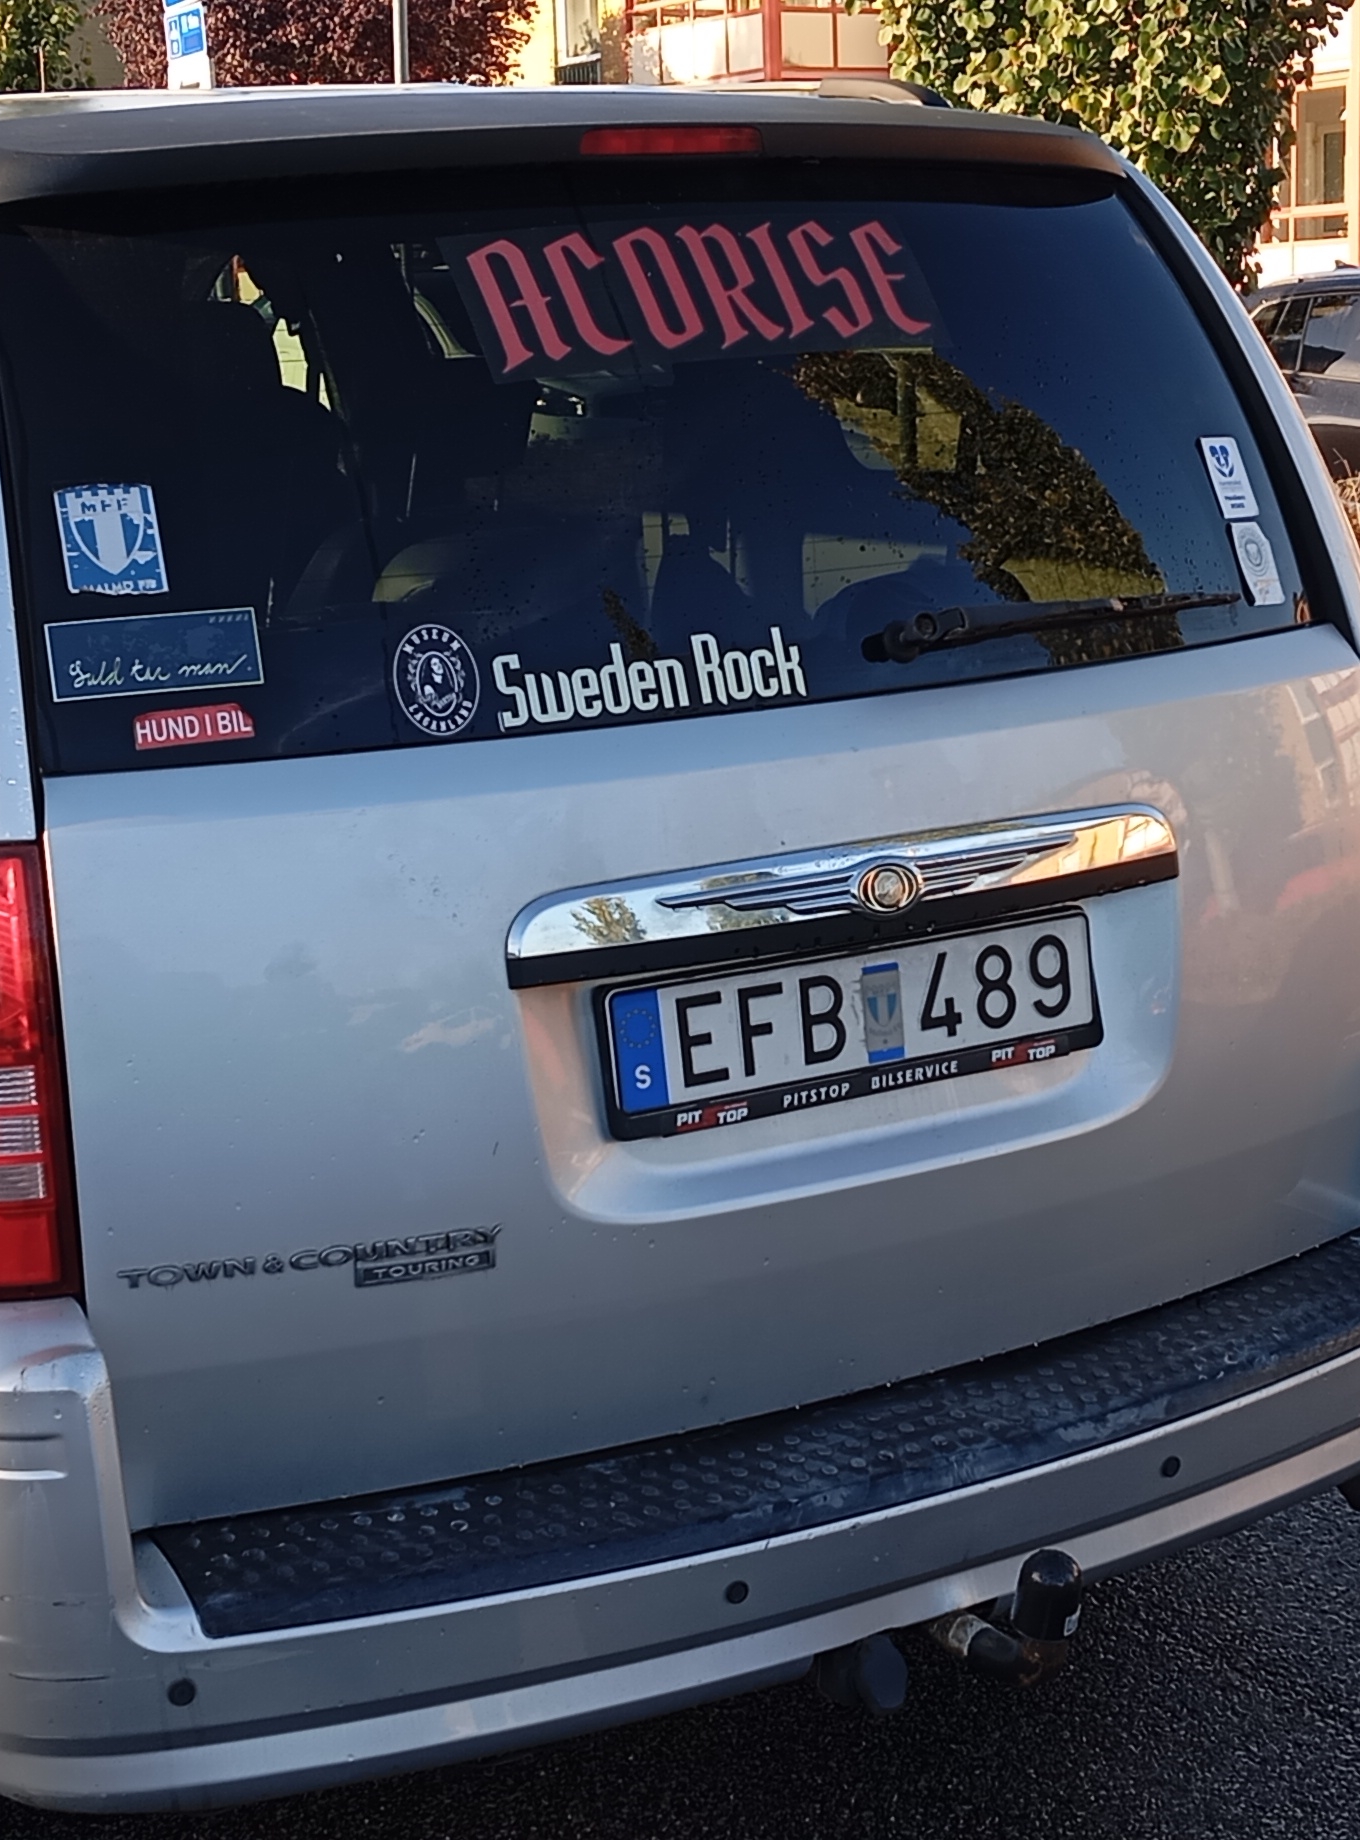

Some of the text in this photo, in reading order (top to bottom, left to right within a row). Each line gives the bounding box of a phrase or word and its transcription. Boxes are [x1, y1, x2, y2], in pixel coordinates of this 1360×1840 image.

[466, 220, 932, 374] ACORISE
[81, 498, 128, 514] MFF
[402, 628, 462, 655] MUSEUM
[492, 626, 808, 733] Sweden Rock
[135, 710, 253, 744] HUND I BIL
[674, 934, 1072, 1088] EFB 489
[634, 1064, 653, 1090] S
[782, 1060, 959, 1108] PITSTOP BILSERVICE
[117, 1222, 503, 1288] TOWN & COUNTRY
[372, 1254, 480, 1280] TOURING
